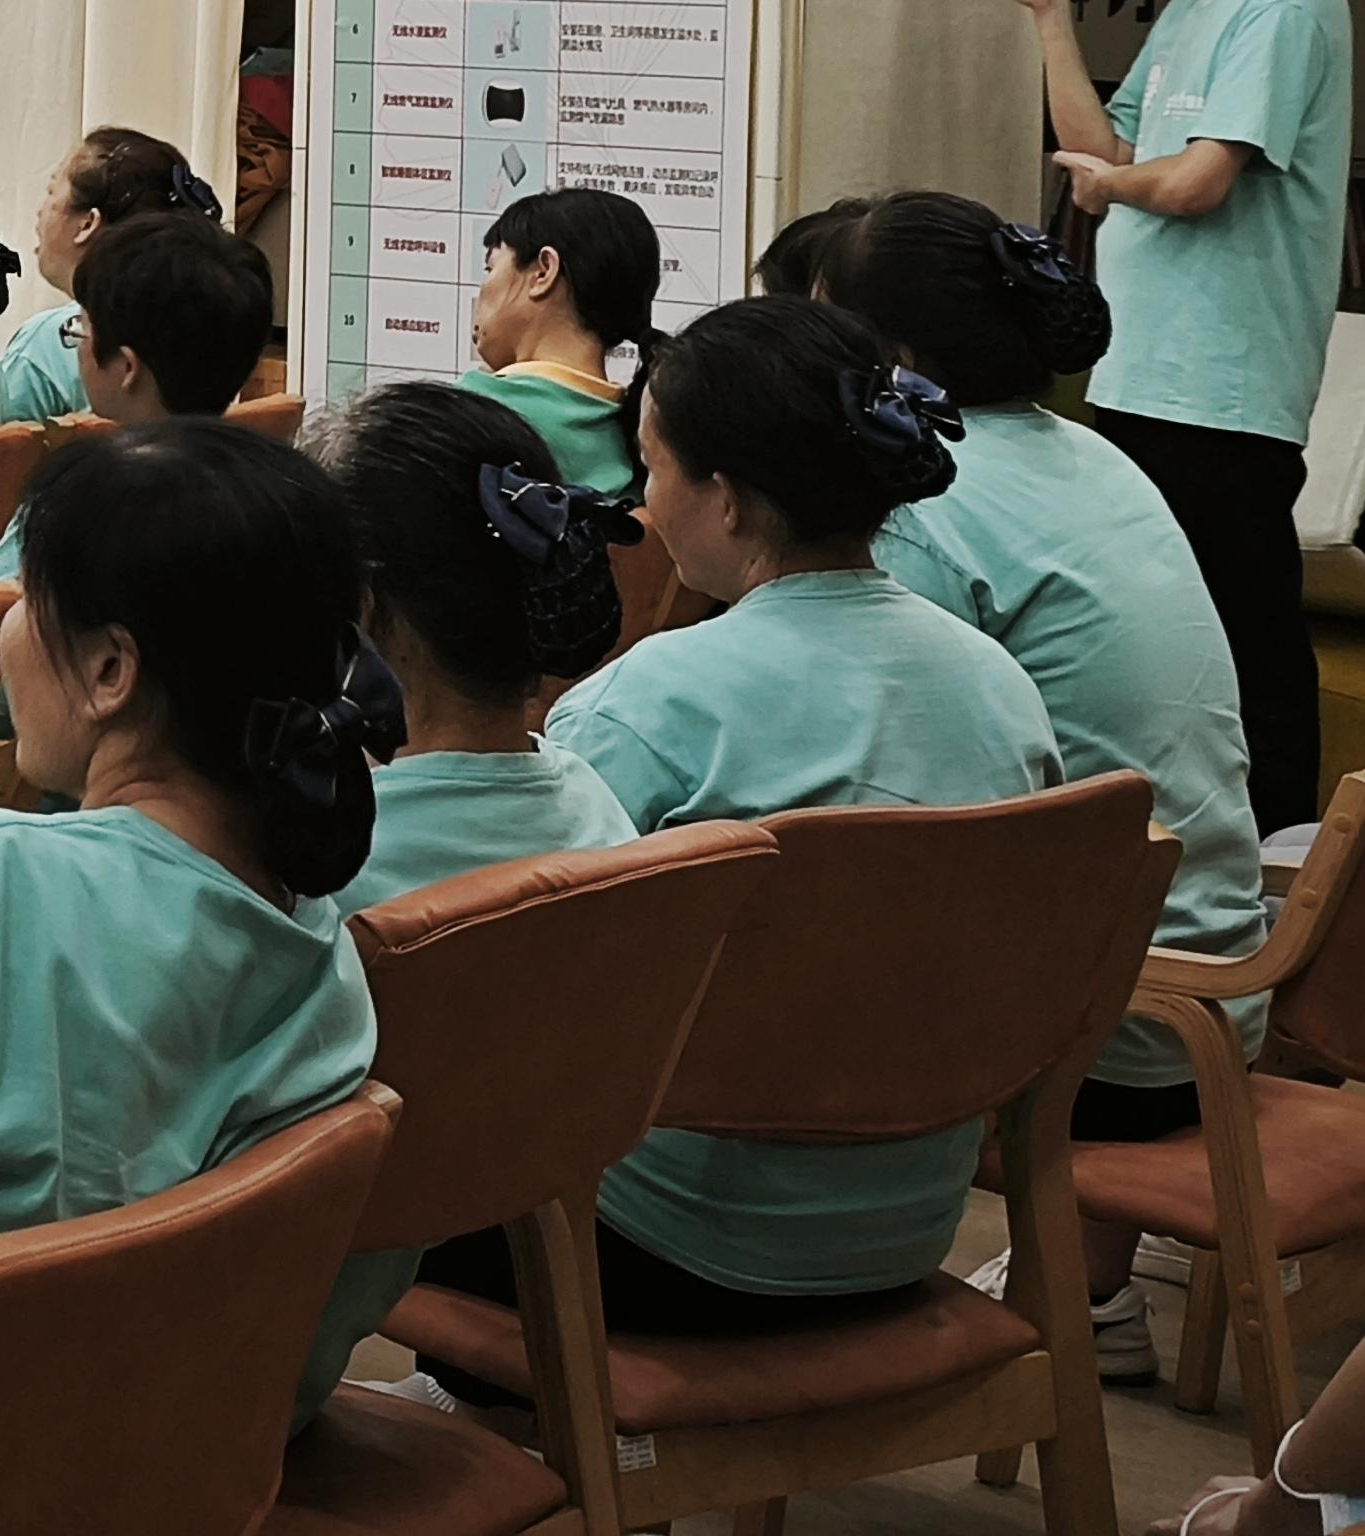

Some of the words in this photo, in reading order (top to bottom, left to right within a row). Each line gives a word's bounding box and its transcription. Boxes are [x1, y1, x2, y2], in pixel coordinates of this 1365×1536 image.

[352, 23, 358, 34] 6
[351, 93, 357, 103] 7
[348, 235, 354, 247] 9
[344, 314, 355, 326] 10
